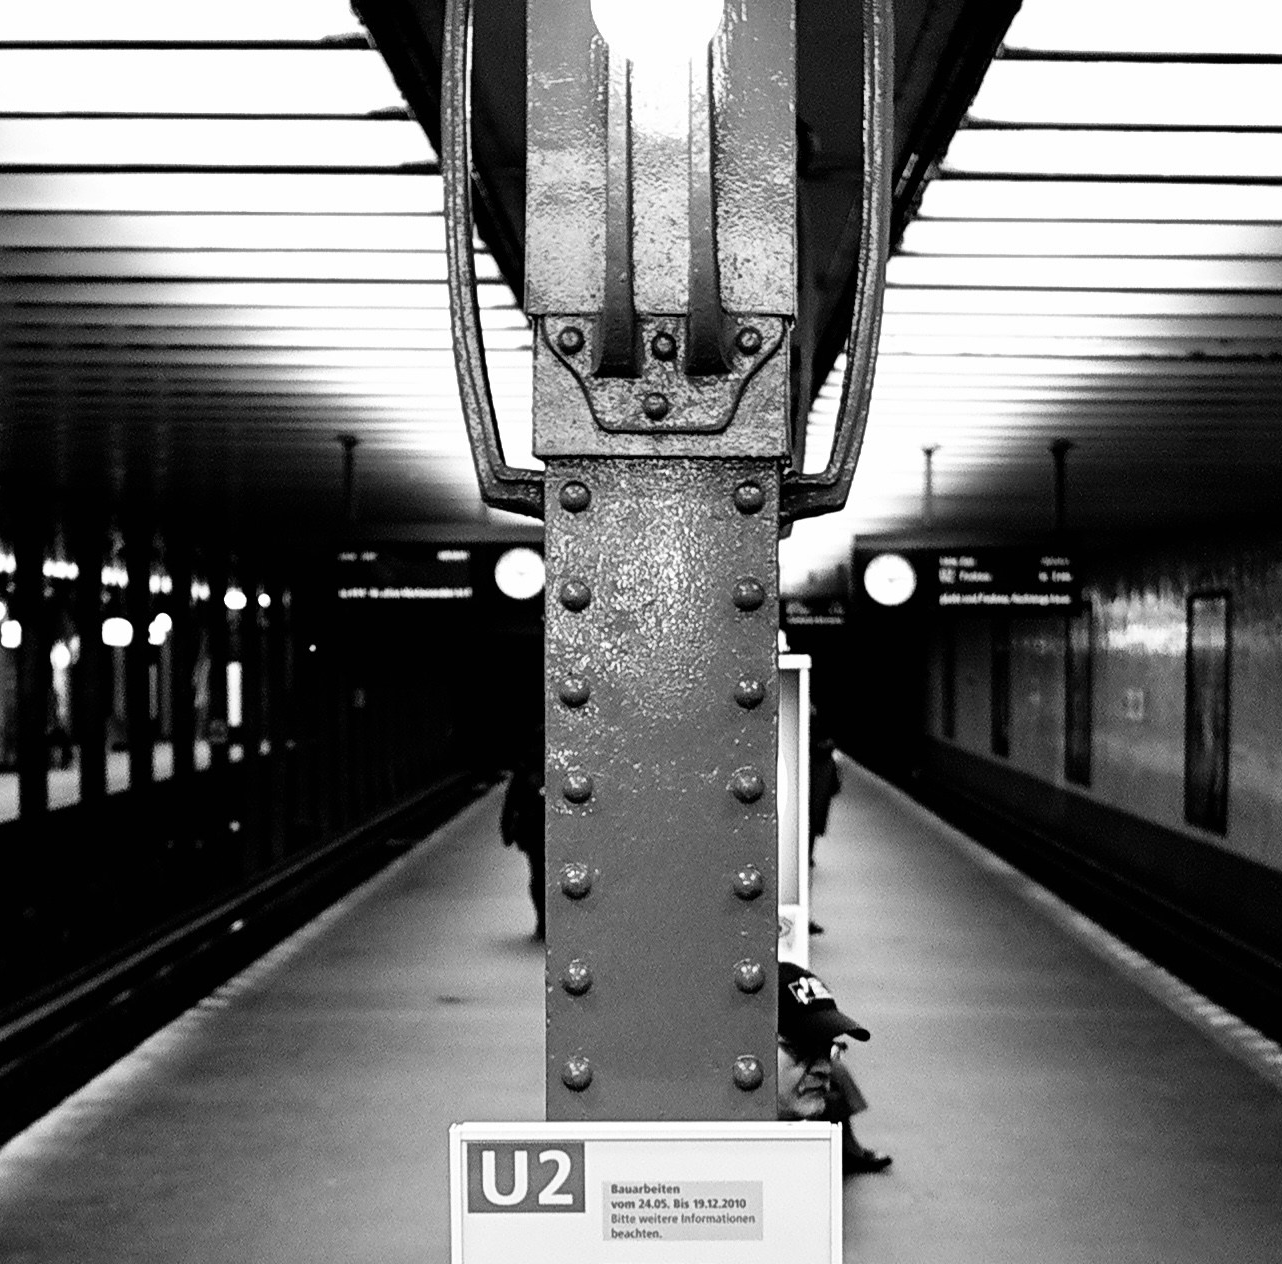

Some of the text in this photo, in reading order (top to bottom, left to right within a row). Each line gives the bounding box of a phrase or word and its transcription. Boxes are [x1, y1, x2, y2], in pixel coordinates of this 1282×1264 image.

[481, 1149, 574, 1206] U2
[610, 1183, 680, 1195] Bauarbeiten
[610, 1198, 747, 1210] vom 24.05. Bis 19.12.2010
[610, 1213, 756, 1224] Bitte weitere Informationen
[610, 1228, 663, 1239] beachten.
